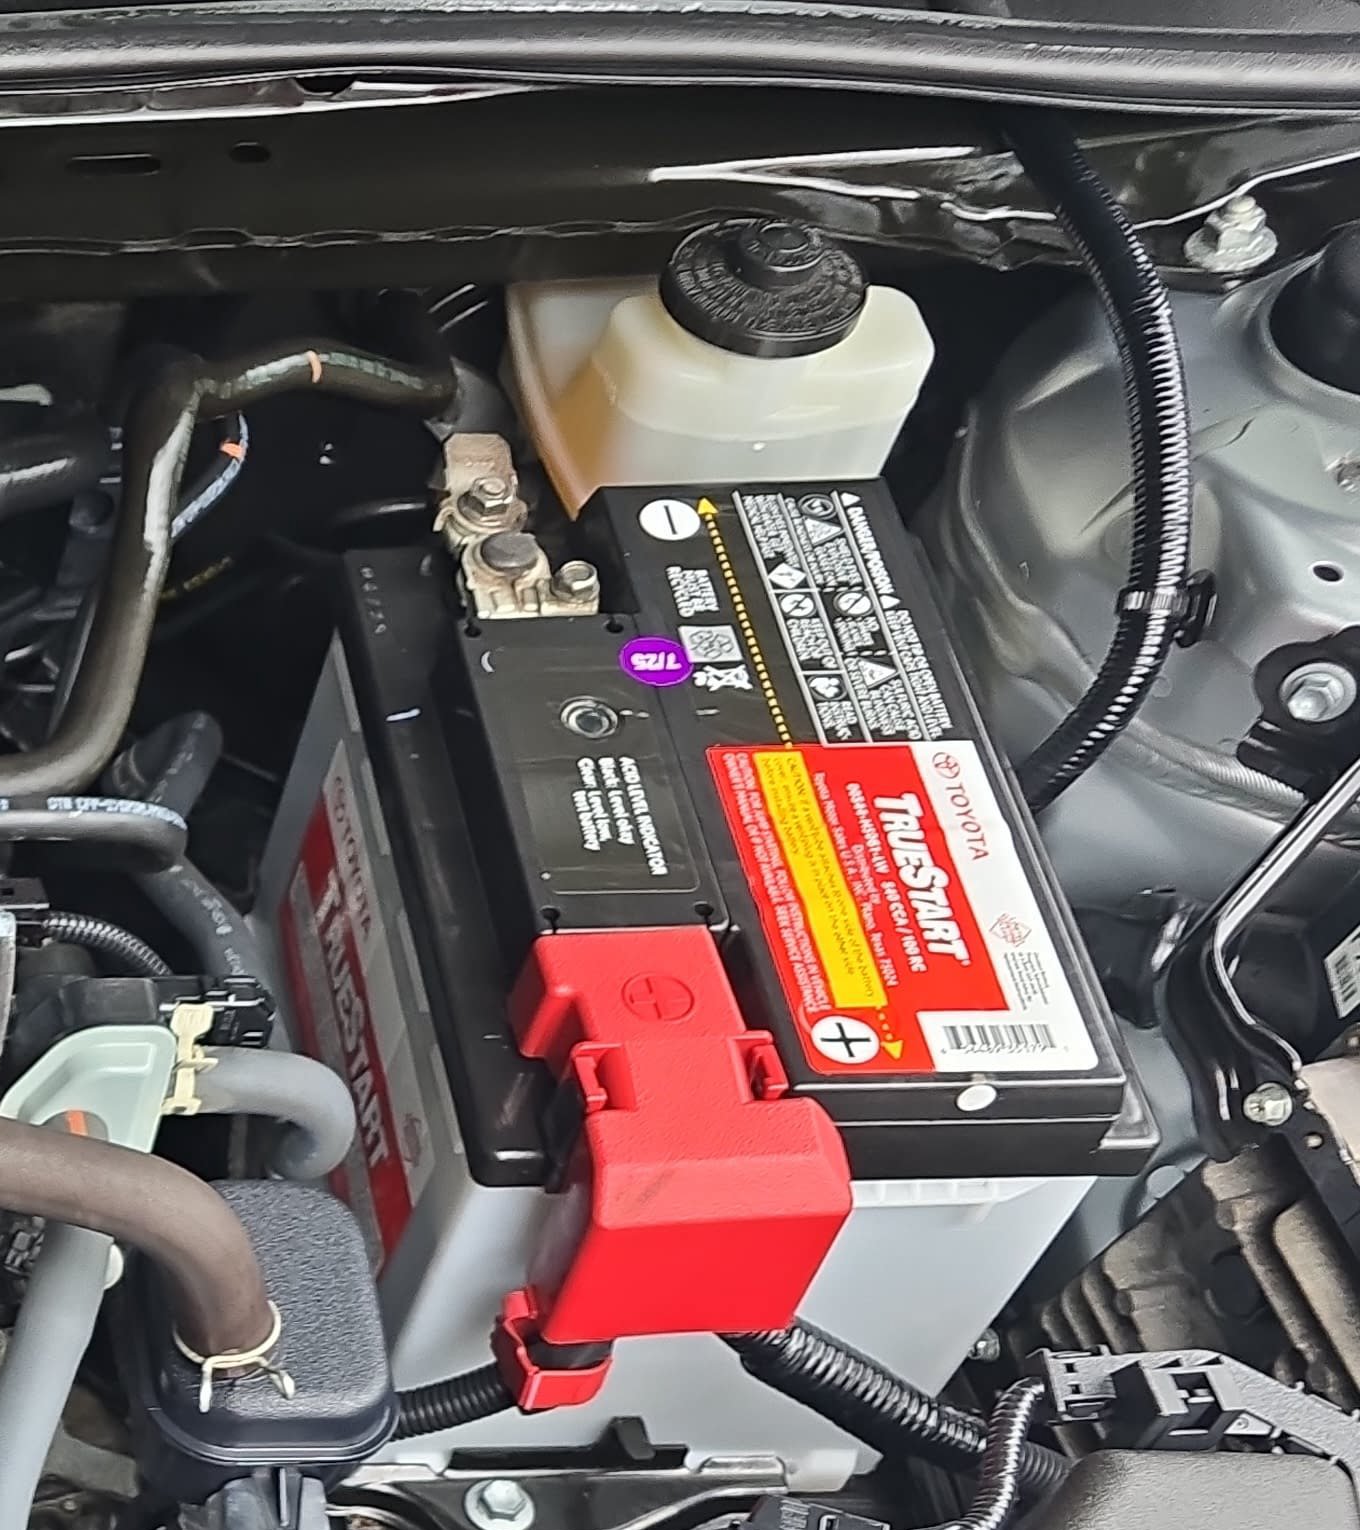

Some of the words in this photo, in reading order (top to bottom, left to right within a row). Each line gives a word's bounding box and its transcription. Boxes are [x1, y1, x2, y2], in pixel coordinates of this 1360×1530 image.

[847, 506, 893, 593] DANGER/POISON
[630, 651, 681, 670] 7/25
[619, 756, 640, 783] ACID
[587, 790, 608, 818] Level
[607, 789, 629, 818] Level
[626, 783, 648, 814] LEVEL
[578, 811, 600, 850] battery
[615, 817, 634, 844] okay
[945, 783, 989, 860] TOYOTA
[636, 814, 667, 874] INDICATOR
[889, 902, 908, 926] CCA
[908, 954, 926, 971] RC
